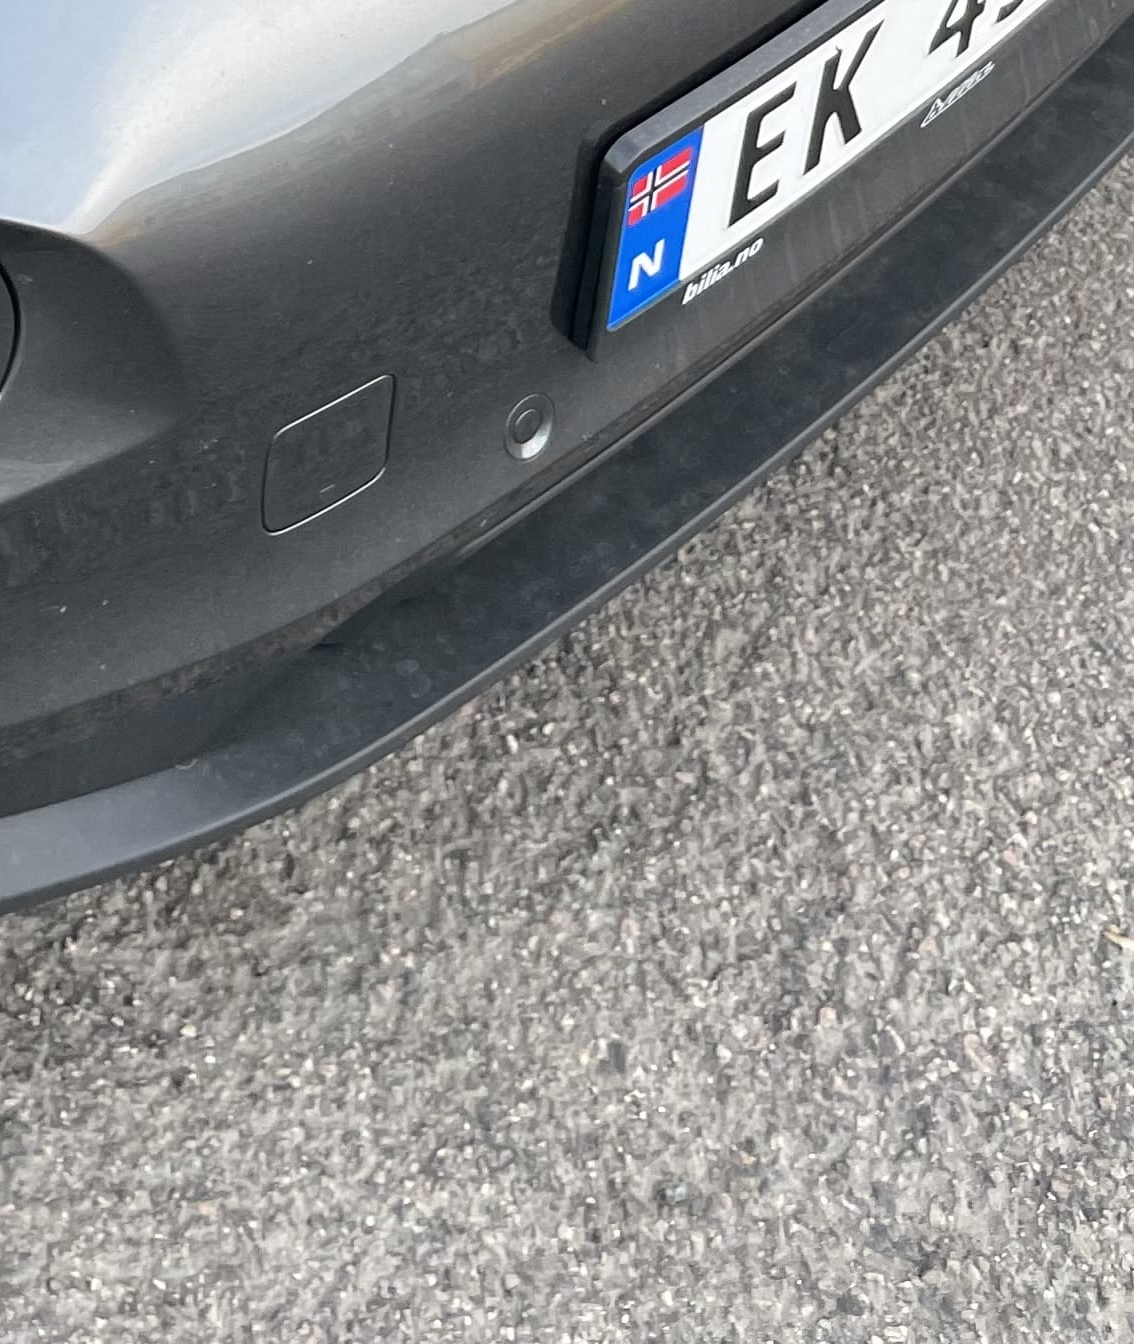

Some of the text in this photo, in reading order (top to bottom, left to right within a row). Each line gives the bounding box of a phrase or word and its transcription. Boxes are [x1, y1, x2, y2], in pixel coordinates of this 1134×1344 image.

[728, 18, 884, 228] EK
[627, 238, 665, 292] N
[681, 237, 764, 306] bilia.no
